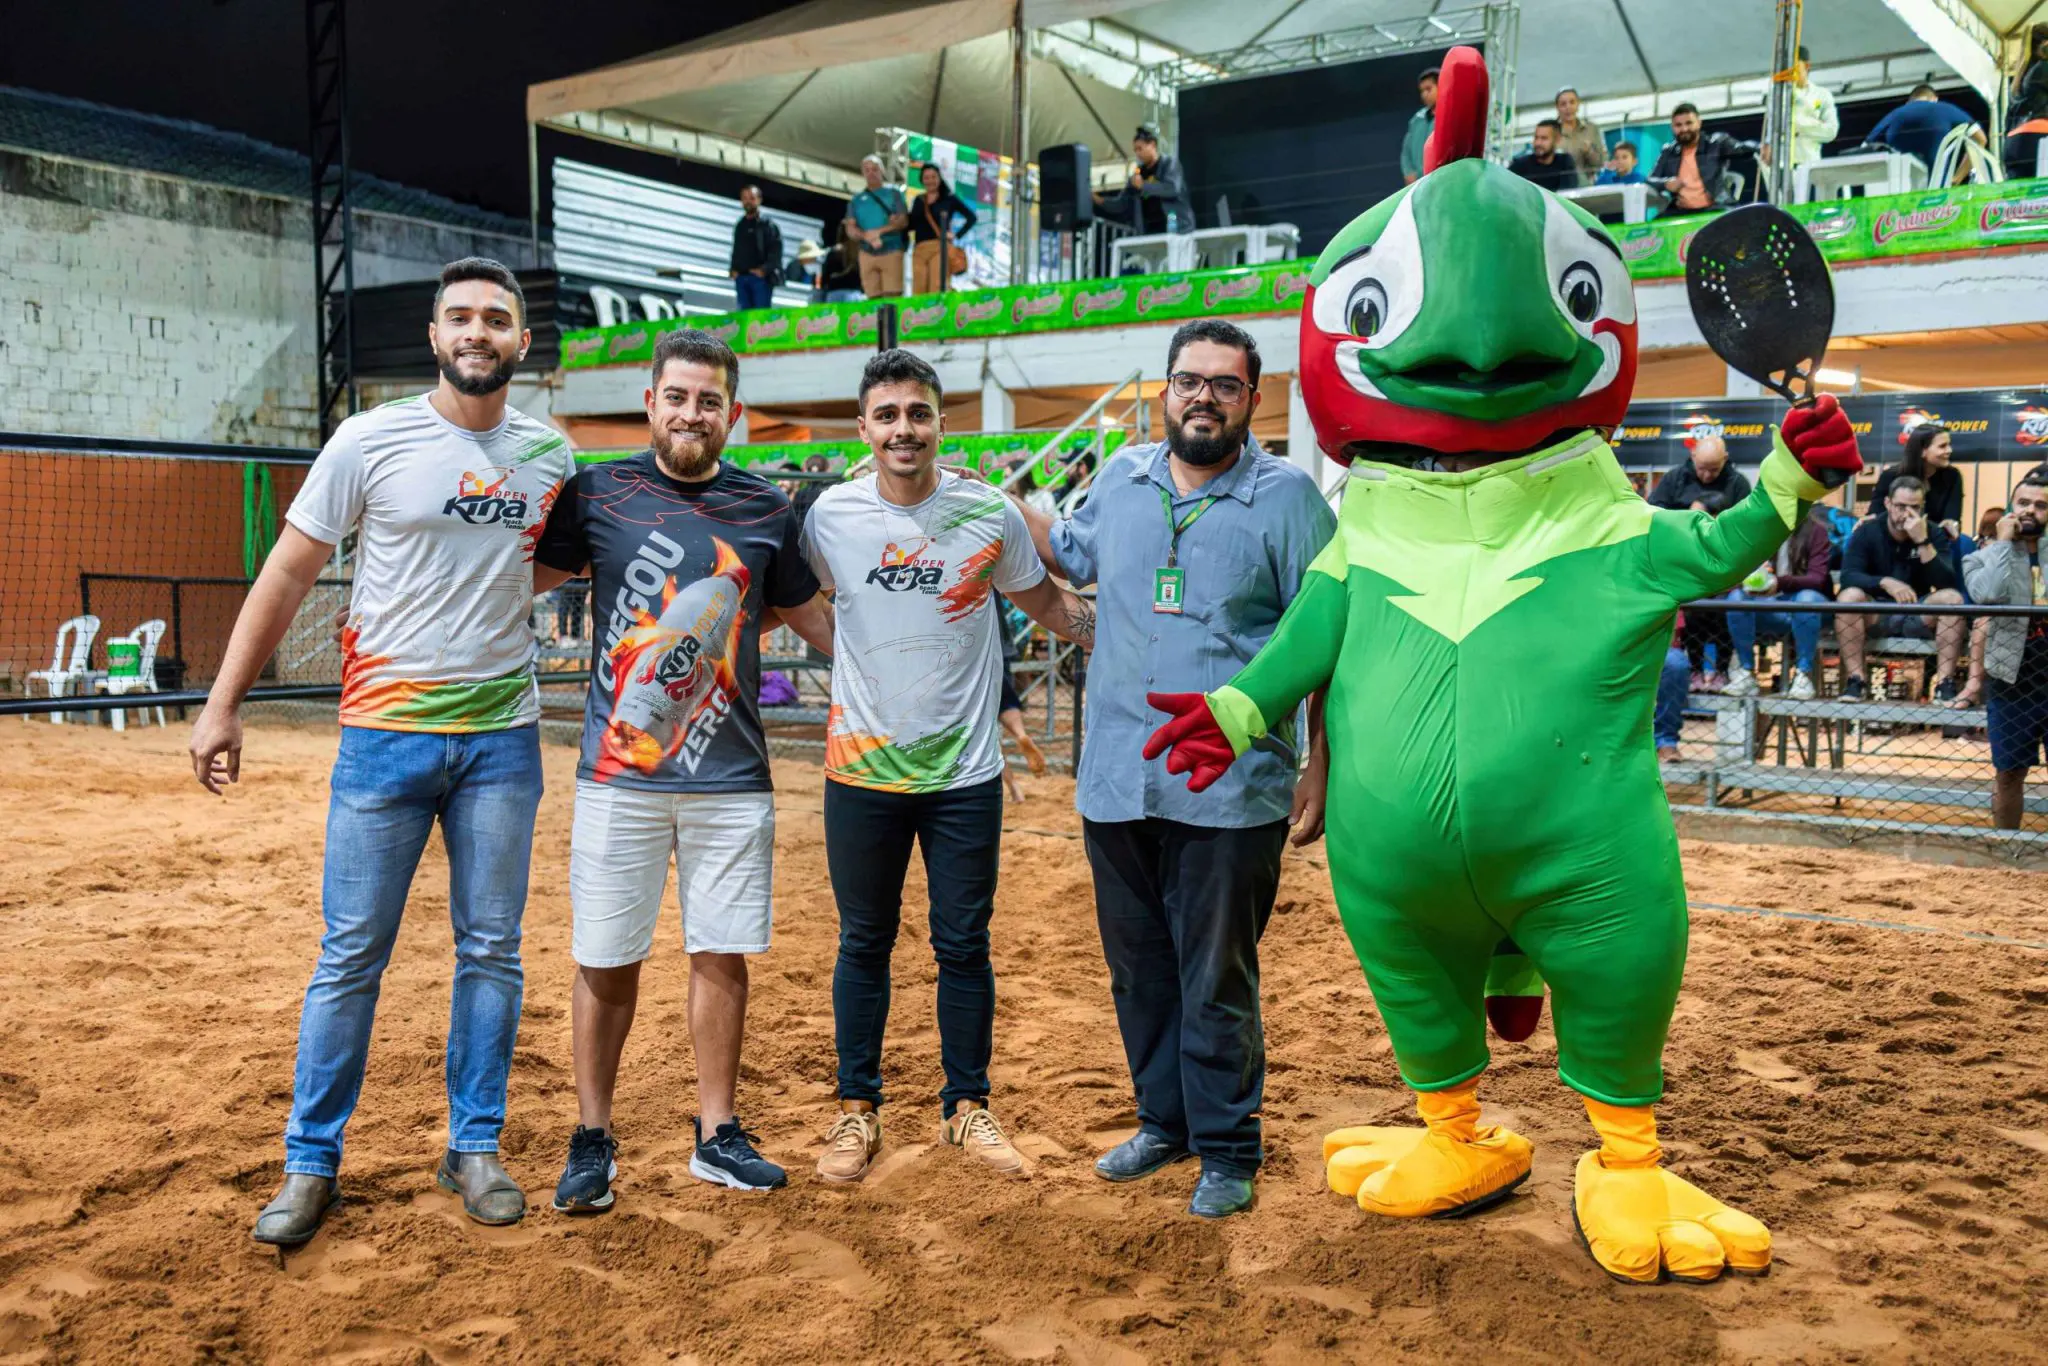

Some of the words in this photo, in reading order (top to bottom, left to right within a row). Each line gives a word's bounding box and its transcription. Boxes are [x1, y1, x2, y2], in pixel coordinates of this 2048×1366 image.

[1623, 427, 1662, 439] POWER
[1724, 424, 1765, 436] POWER
[494, 490, 528, 501] OPEN
[505, 523, 526, 531] Tennis
[912, 559, 945, 568] OPEN
[597, 530, 685, 692] CHEGOU
[676, 687, 731, 775] ZERO
